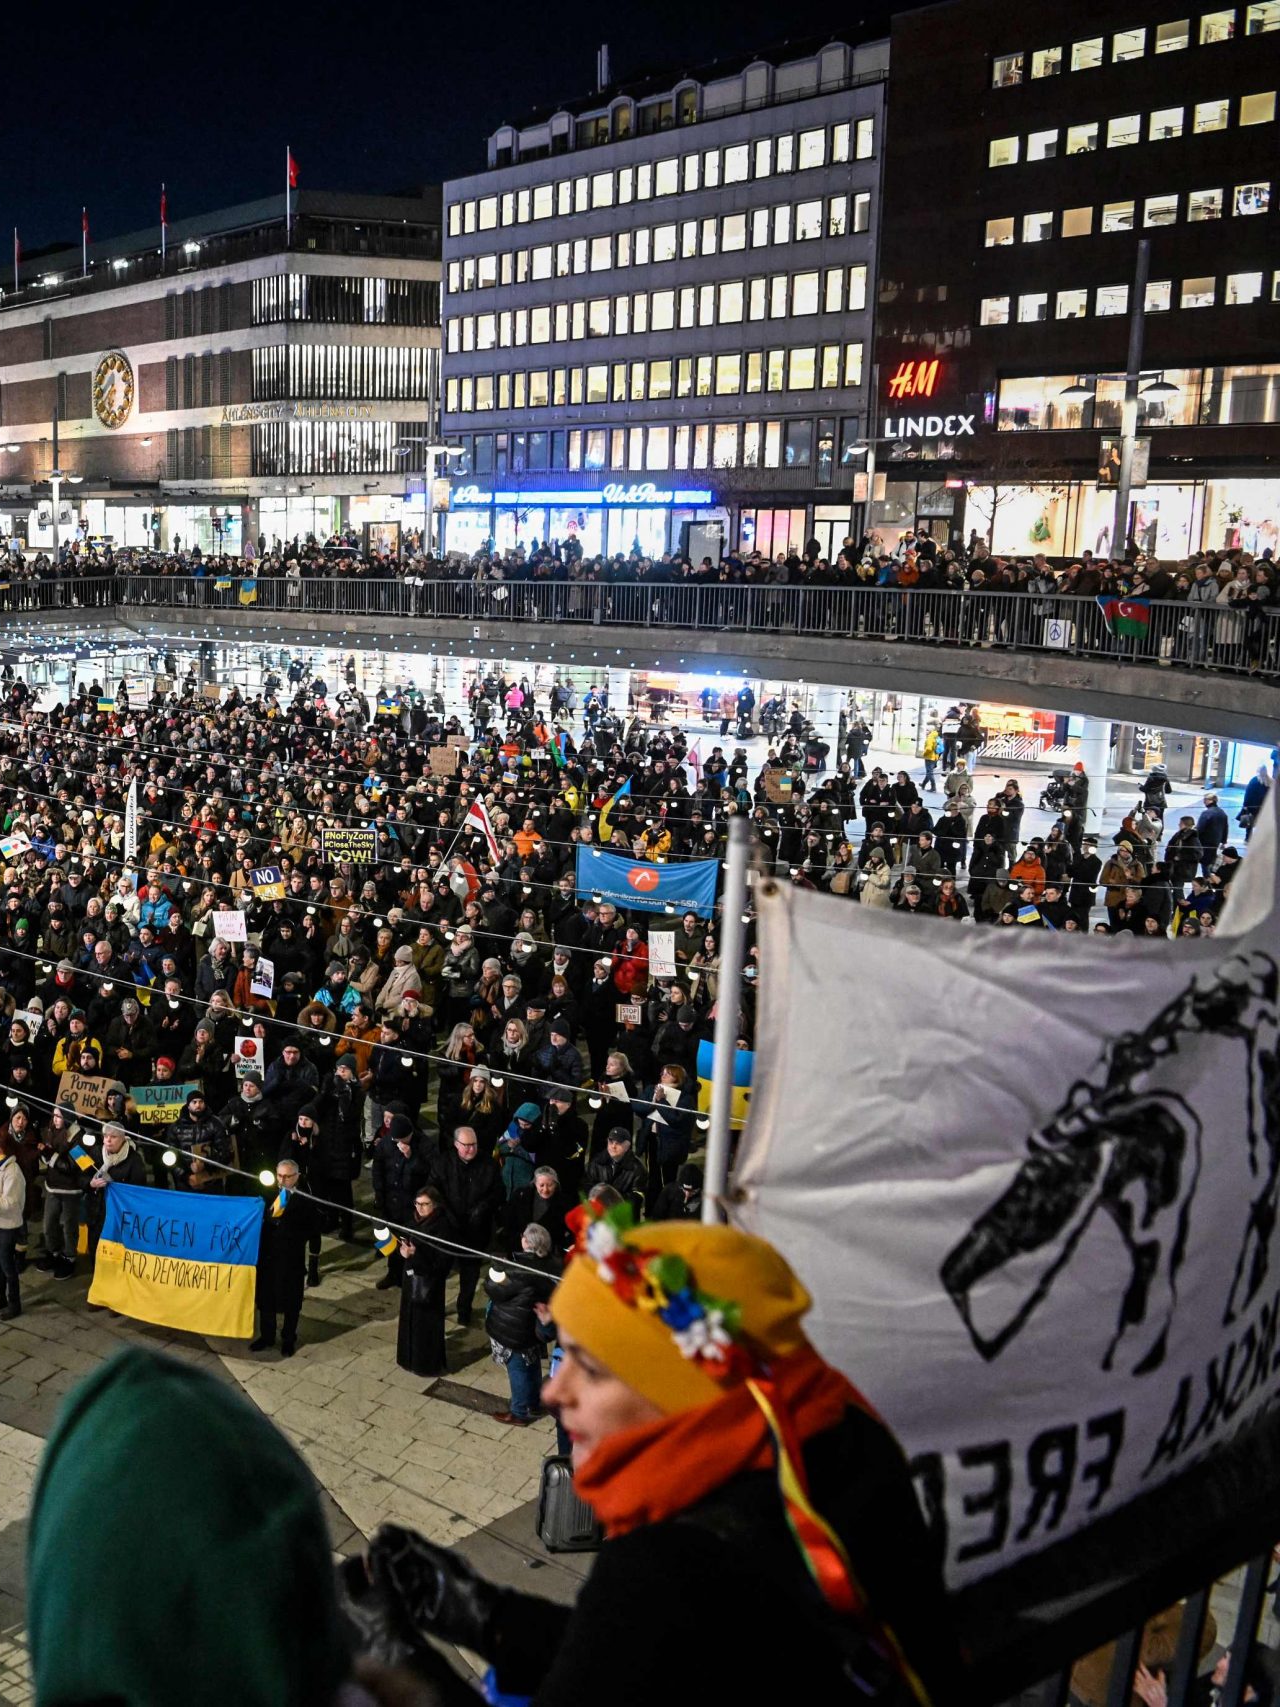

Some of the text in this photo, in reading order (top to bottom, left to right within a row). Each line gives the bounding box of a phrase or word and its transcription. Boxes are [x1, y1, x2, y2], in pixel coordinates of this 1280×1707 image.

[889, 359, 939, 398] H&M
[222, 405, 260, 422] ÅHLÉNS
[293, 402, 345, 418] ÅHLÉNS
[884, 415, 975, 438] LINDEX
[324, 831, 374, 841] #NoFlyZone
[324, 841, 374, 850] #CloseTheSky
[327, 850, 372, 863] NOW!
[255, 869, 274, 884] NO
[622, 1006, 638, 1014] STOP
[60, 1089, 79, 1103] GO
[145, 1087, 183, 1102] PUTIN
[121, 1210, 244, 1253] FACKEN FÖR
